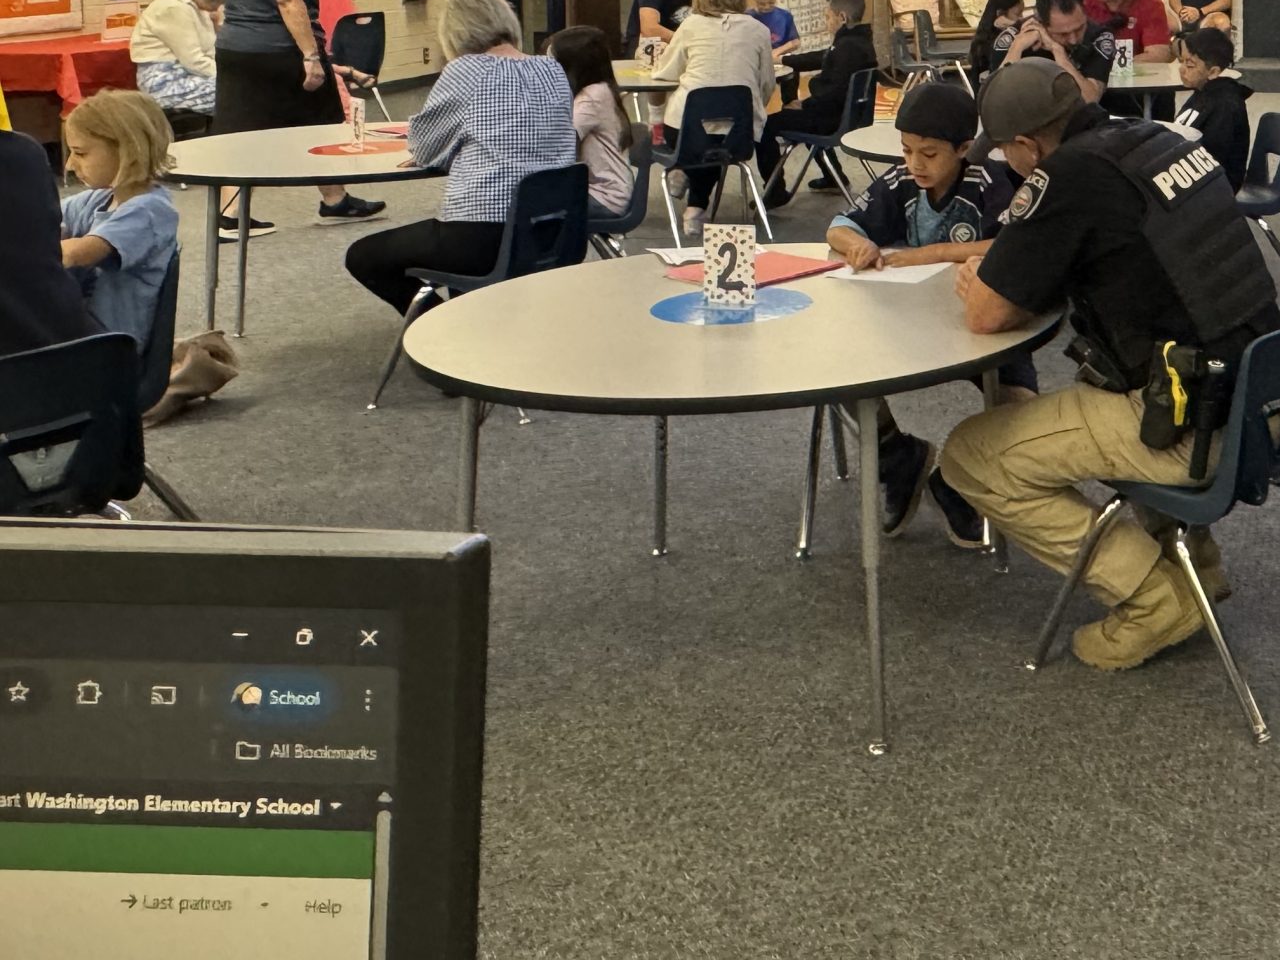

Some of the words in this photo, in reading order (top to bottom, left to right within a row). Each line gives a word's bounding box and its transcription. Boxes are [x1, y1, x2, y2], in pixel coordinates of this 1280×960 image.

[717, 242, 748, 294] 2
[269, 689, 321, 706] School
[270, 743, 290, 759] All
[294, 744, 378, 761] Bookmarks
[26, 792, 140, 815] Washington
[144, 795, 251, 818] Elementary
[256, 797, 321, 816] School
[142, 894, 174, 910] Last
[179, 896, 233, 914] patron
[305, 898, 343, 918] Help
